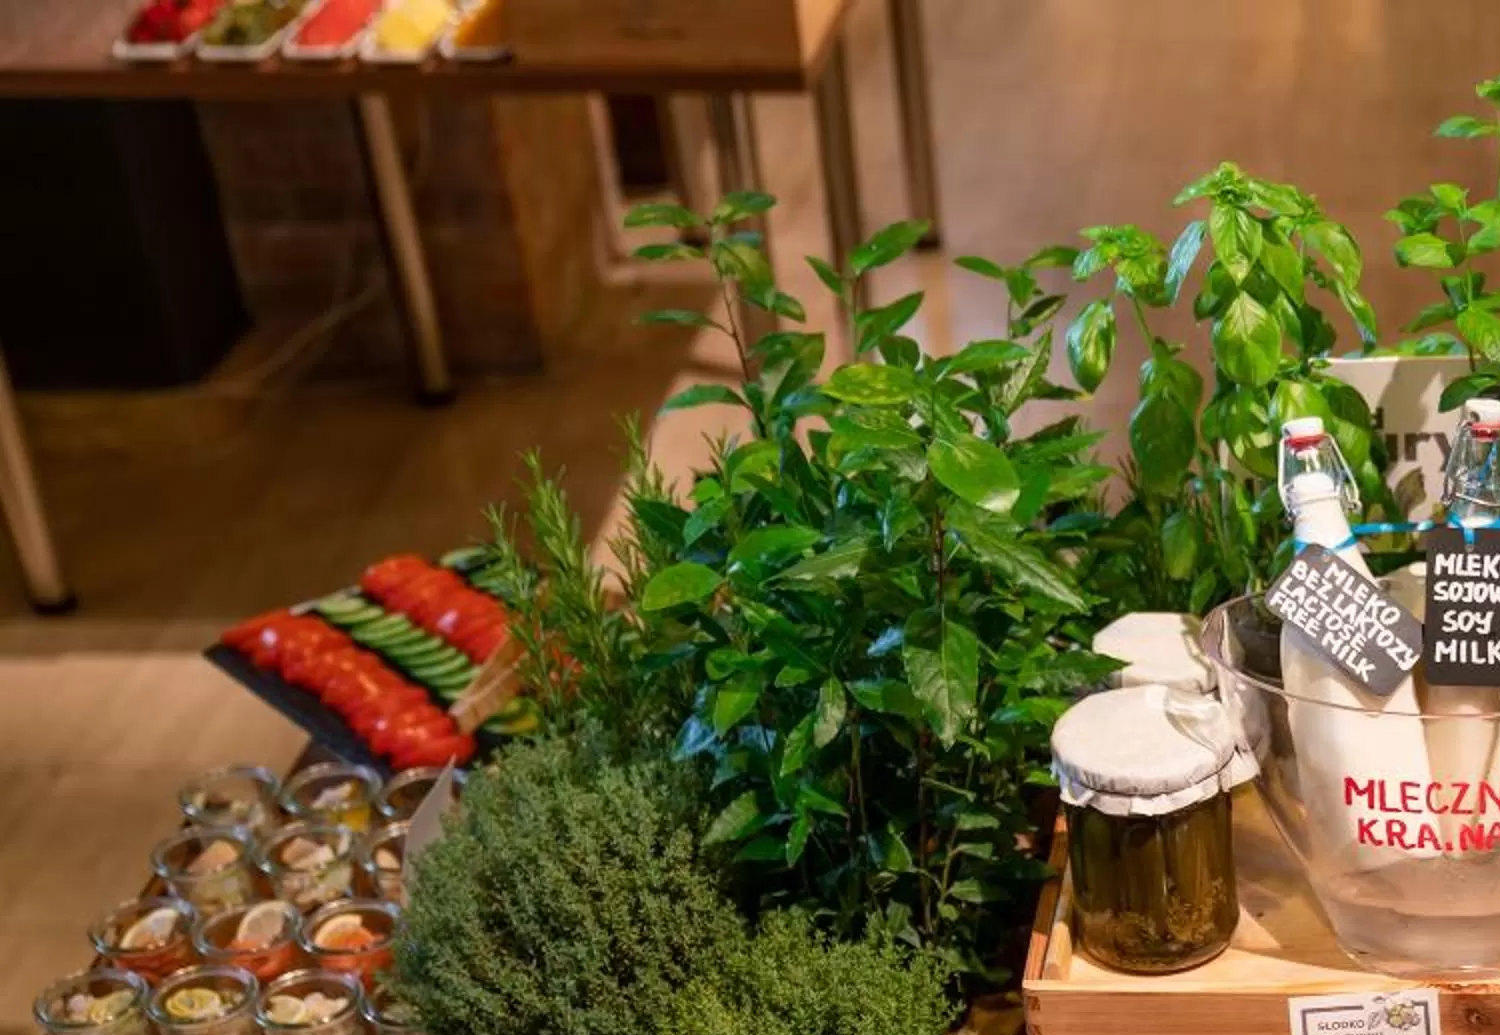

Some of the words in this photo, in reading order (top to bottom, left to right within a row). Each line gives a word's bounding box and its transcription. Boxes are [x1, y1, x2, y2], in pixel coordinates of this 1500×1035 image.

[1279, 576, 1367, 652] LACTOSE
[1292, 560, 1332, 600] BEZ
[1324, 562, 1400, 626] MLEKO
[1269, 591, 1321, 638] FREE
[1322, 631, 1376, 682] MILK
[1332, 594, 1420, 671] LAKTOZY
[1441, 609, 1494, 635] SOY
